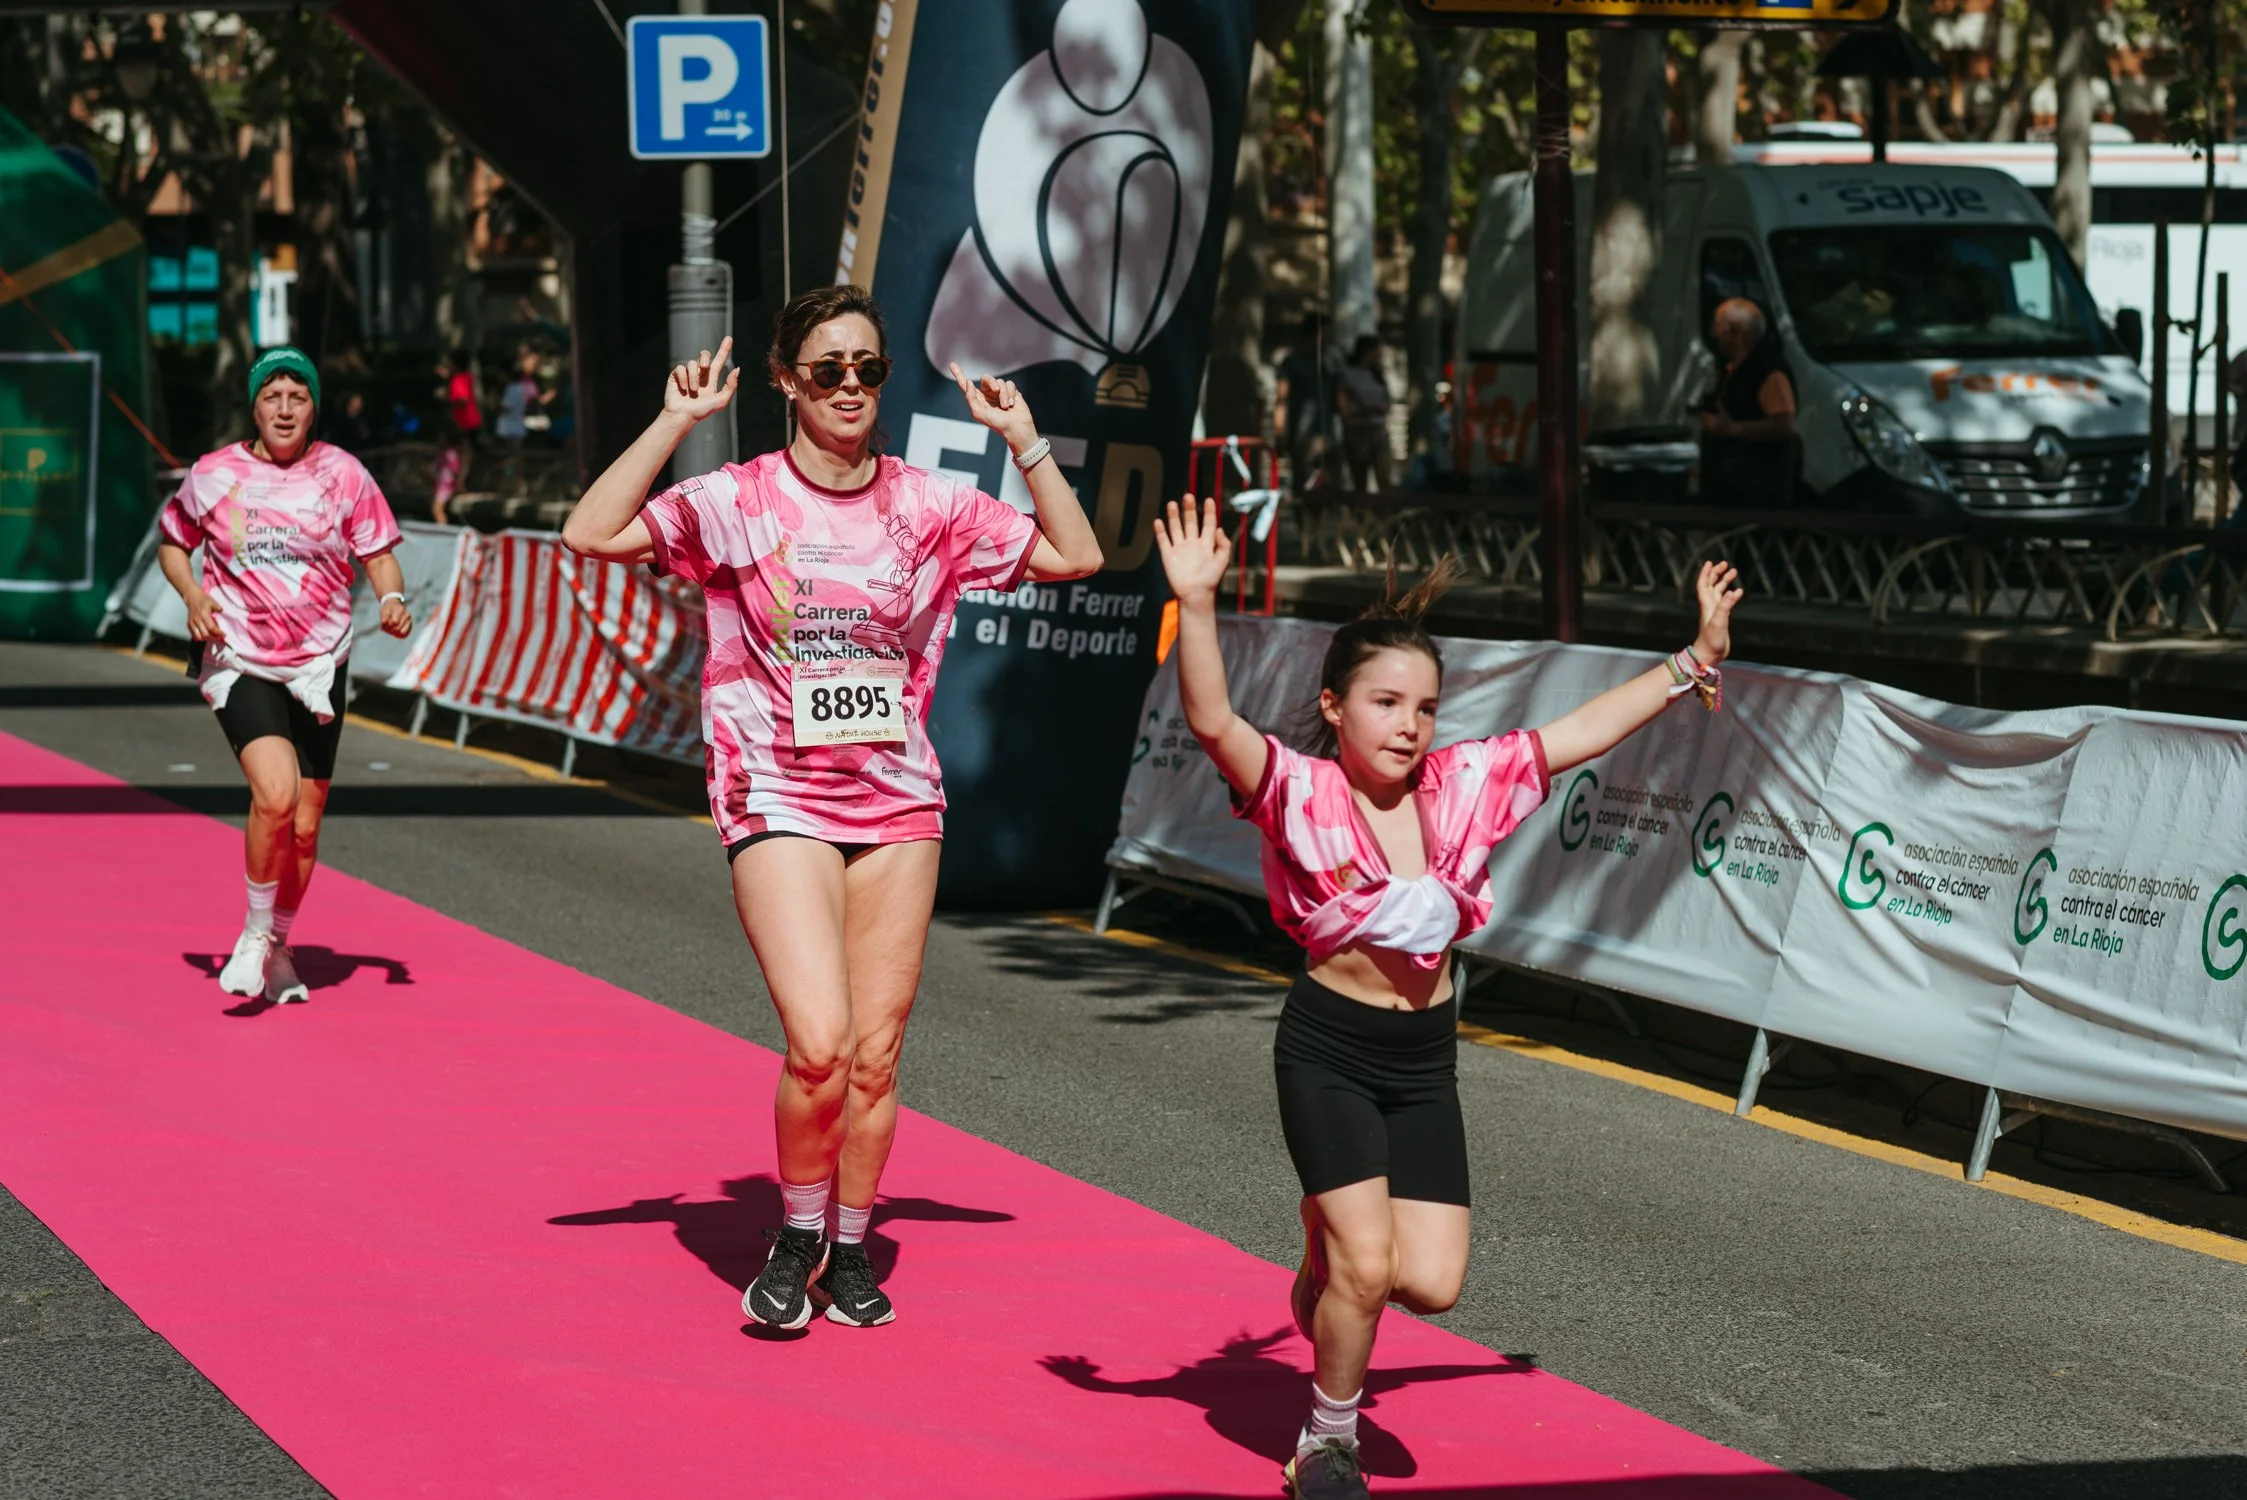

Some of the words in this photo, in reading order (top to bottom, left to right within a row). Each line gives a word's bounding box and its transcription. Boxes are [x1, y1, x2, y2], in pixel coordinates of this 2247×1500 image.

[658, 34, 740, 141] P
[1838, 180, 1989, 217] sapje
[247, 541, 268, 552] por
[272, 539, 285, 550] la
[815, 556, 830, 564] Rioja
[794, 578, 813, 596] XI
[1068, 585, 1144, 618] Ferrer
[793, 602, 869, 621] Carrera
[793, 630, 826, 644] por
[829, 626, 847, 641] la
[975, 615, 1010, 646] el
[1027, 618, 1138, 660] Deporte
[811, 685, 891, 721] 8895
[1597, 809, 1628, 828] contra
[1628, 811, 1637, 829] el
[1735, 835, 1767, 853] contra
[1768, 837, 1778, 856] el
[1904, 843, 1967, 868] asociación
[1969, 854, 2020, 876] española
[1896, 868, 1937, 890] contra
[1938, 873, 1951, 893] el
[1951, 877, 1991, 901] cáncer
[2068, 866, 2137, 893] asociación
[2139, 876, 2200, 902] española
[1887, 897, 1904, 912] en
[1905, 896, 1922, 918] La
[1923, 899, 1952, 927] Rioja
[2061, 895, 2103, 918] contra
[2105, 898, 2118, 921] el
[2119, 902, 2166, 928] cáncer
[2053, 925, 2069, 944] en
[2071, 924, 2089, 948] La
[2091, 928, 2124, 958] Rioja
